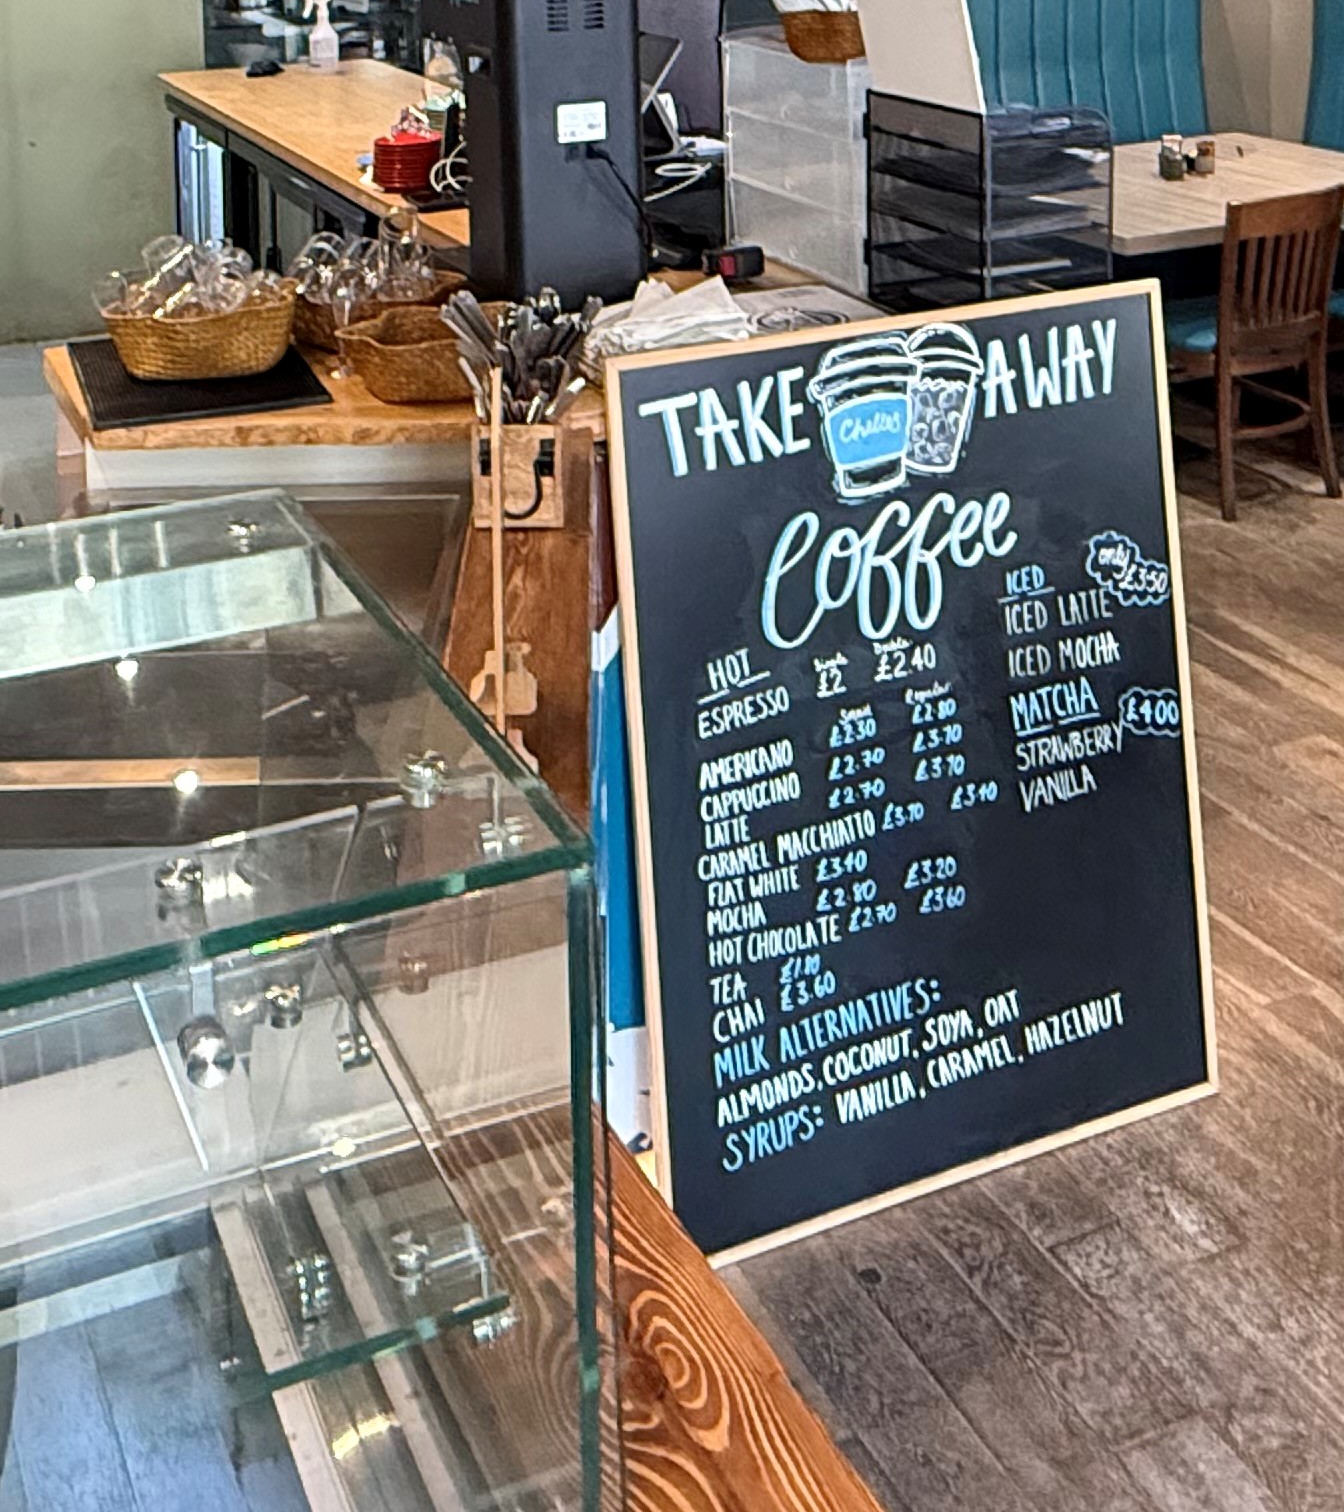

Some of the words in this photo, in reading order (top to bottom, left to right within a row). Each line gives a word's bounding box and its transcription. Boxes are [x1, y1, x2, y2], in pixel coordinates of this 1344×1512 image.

[639, 366, 811, 477] TAKE
[983, 318, 1117, 419] AWAY
[762, 492, 1018, 648] Coffee
[1005, 564, 1046, 596] ICED
[1097, 542, 1131, 580] only
[1004, 600, 1049, 636] ICED
[1057, 589, 1114, 627] LATTE
[706, 647, 752, 692] HOT
[1007, 643, 1053, 678] ICED
[1058, 629, 1122, 672] MOCHA
[697, 686, 790, 739] ESPRESSO
[1009, 675, 1100, 733] MATCHA
[699, 738, 794, 792] AMERICANO
[1015, 721, 1124, 772] STRAWBERRY
[700, 771, 802, 823] CAPPUCCINO
[1018, 763, 1098, 814] VANILLA
[697, 840, 772, 882] CARAMEL
[776, 808, 877, 864] MACCHIATTO
[704, 814, 752, 850] LATTE
[707, 880, 747, 908] FLAT
[748, 864, 801, 899] WHITE
[707, 900, 767, 937] MOCHA
[708, 936, 743, 968] HOT
[746, 913, 843, 964] CHOCOLATE
[709, 971, 748, 1006] TEA
[712, 996, 766, 1044] CHAI
[713, 1033, 771, 1089] MILK
[778, 977, 941, 1064] ALTERNATIVES:
[716, 1062, 824, 1128] ALMONDS,
[921, 1008, 984, 1052] SOYA,
[983, 988, 1021, 1028] OAT
[721, 1104, 825, 1173] SYRUPS:
[835, 1069, 927, 1124] VANILLA,
[925, 1033, 1025, 1090] CARAMEL,
[1023, 990, 1125, 1057] HAZELNUT
